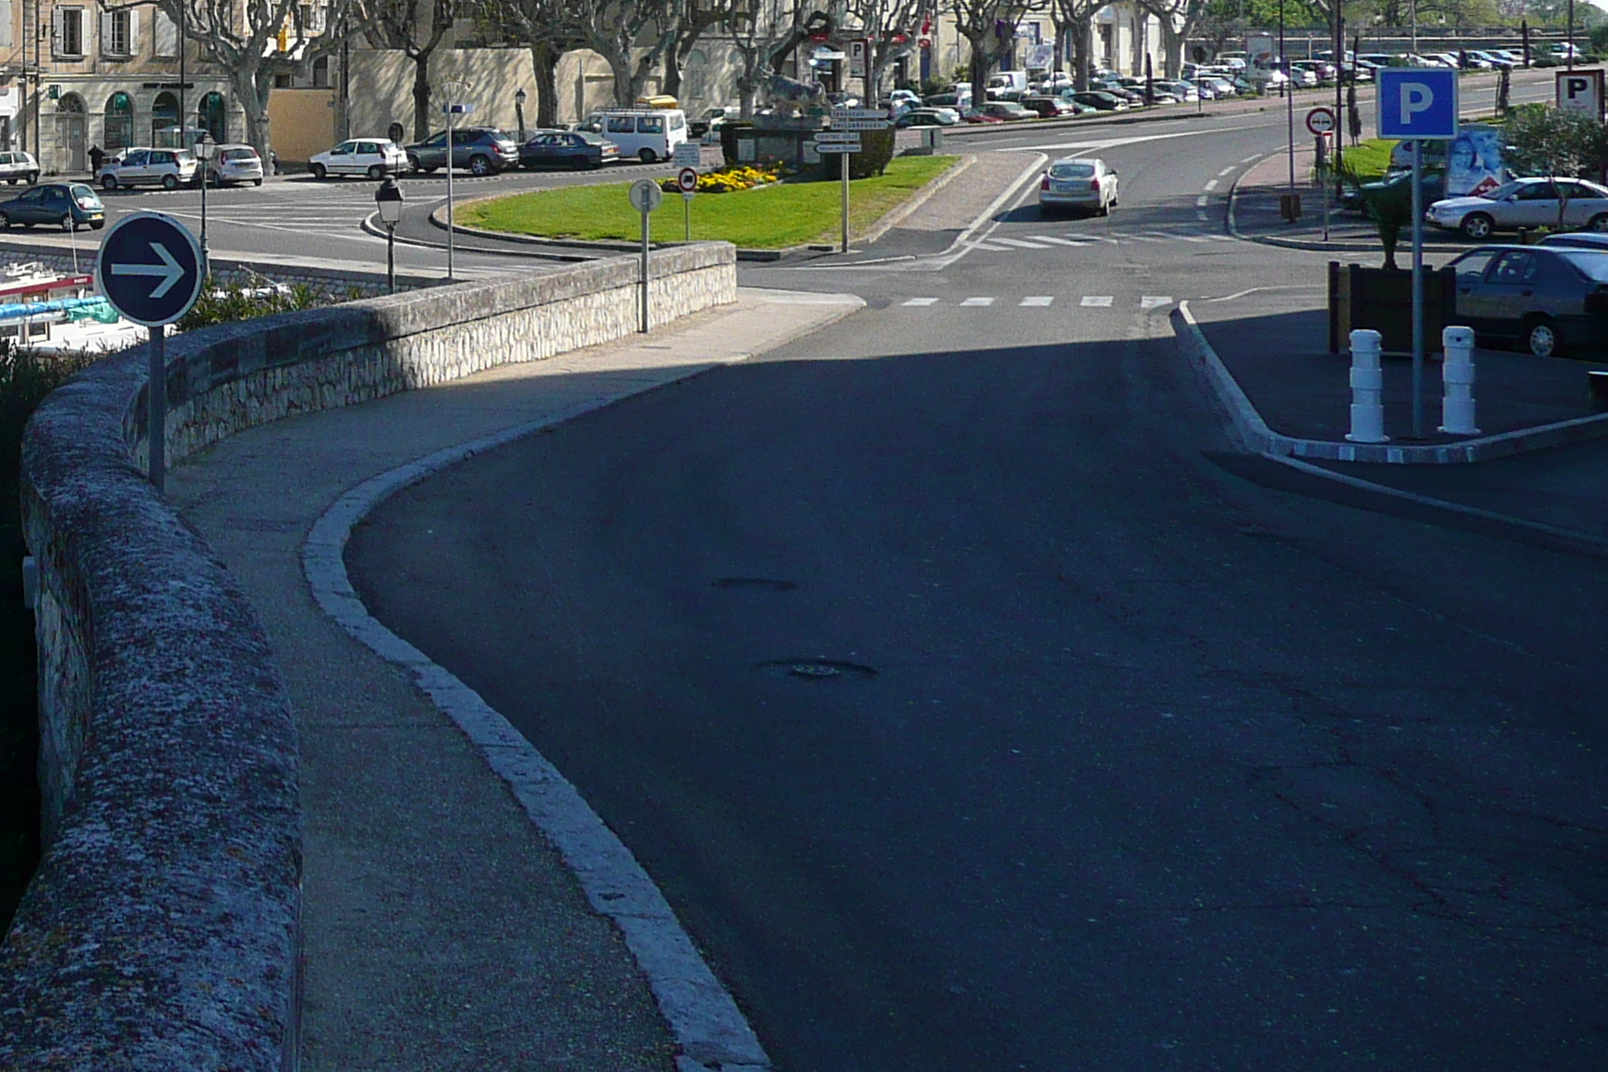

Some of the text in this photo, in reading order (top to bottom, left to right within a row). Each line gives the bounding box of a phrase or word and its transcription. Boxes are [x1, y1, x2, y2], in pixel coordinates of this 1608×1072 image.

[854, 44, 862, 57] P
[1567, 78, 1588, 99] P
[1400, 82, 1434, 125] P
